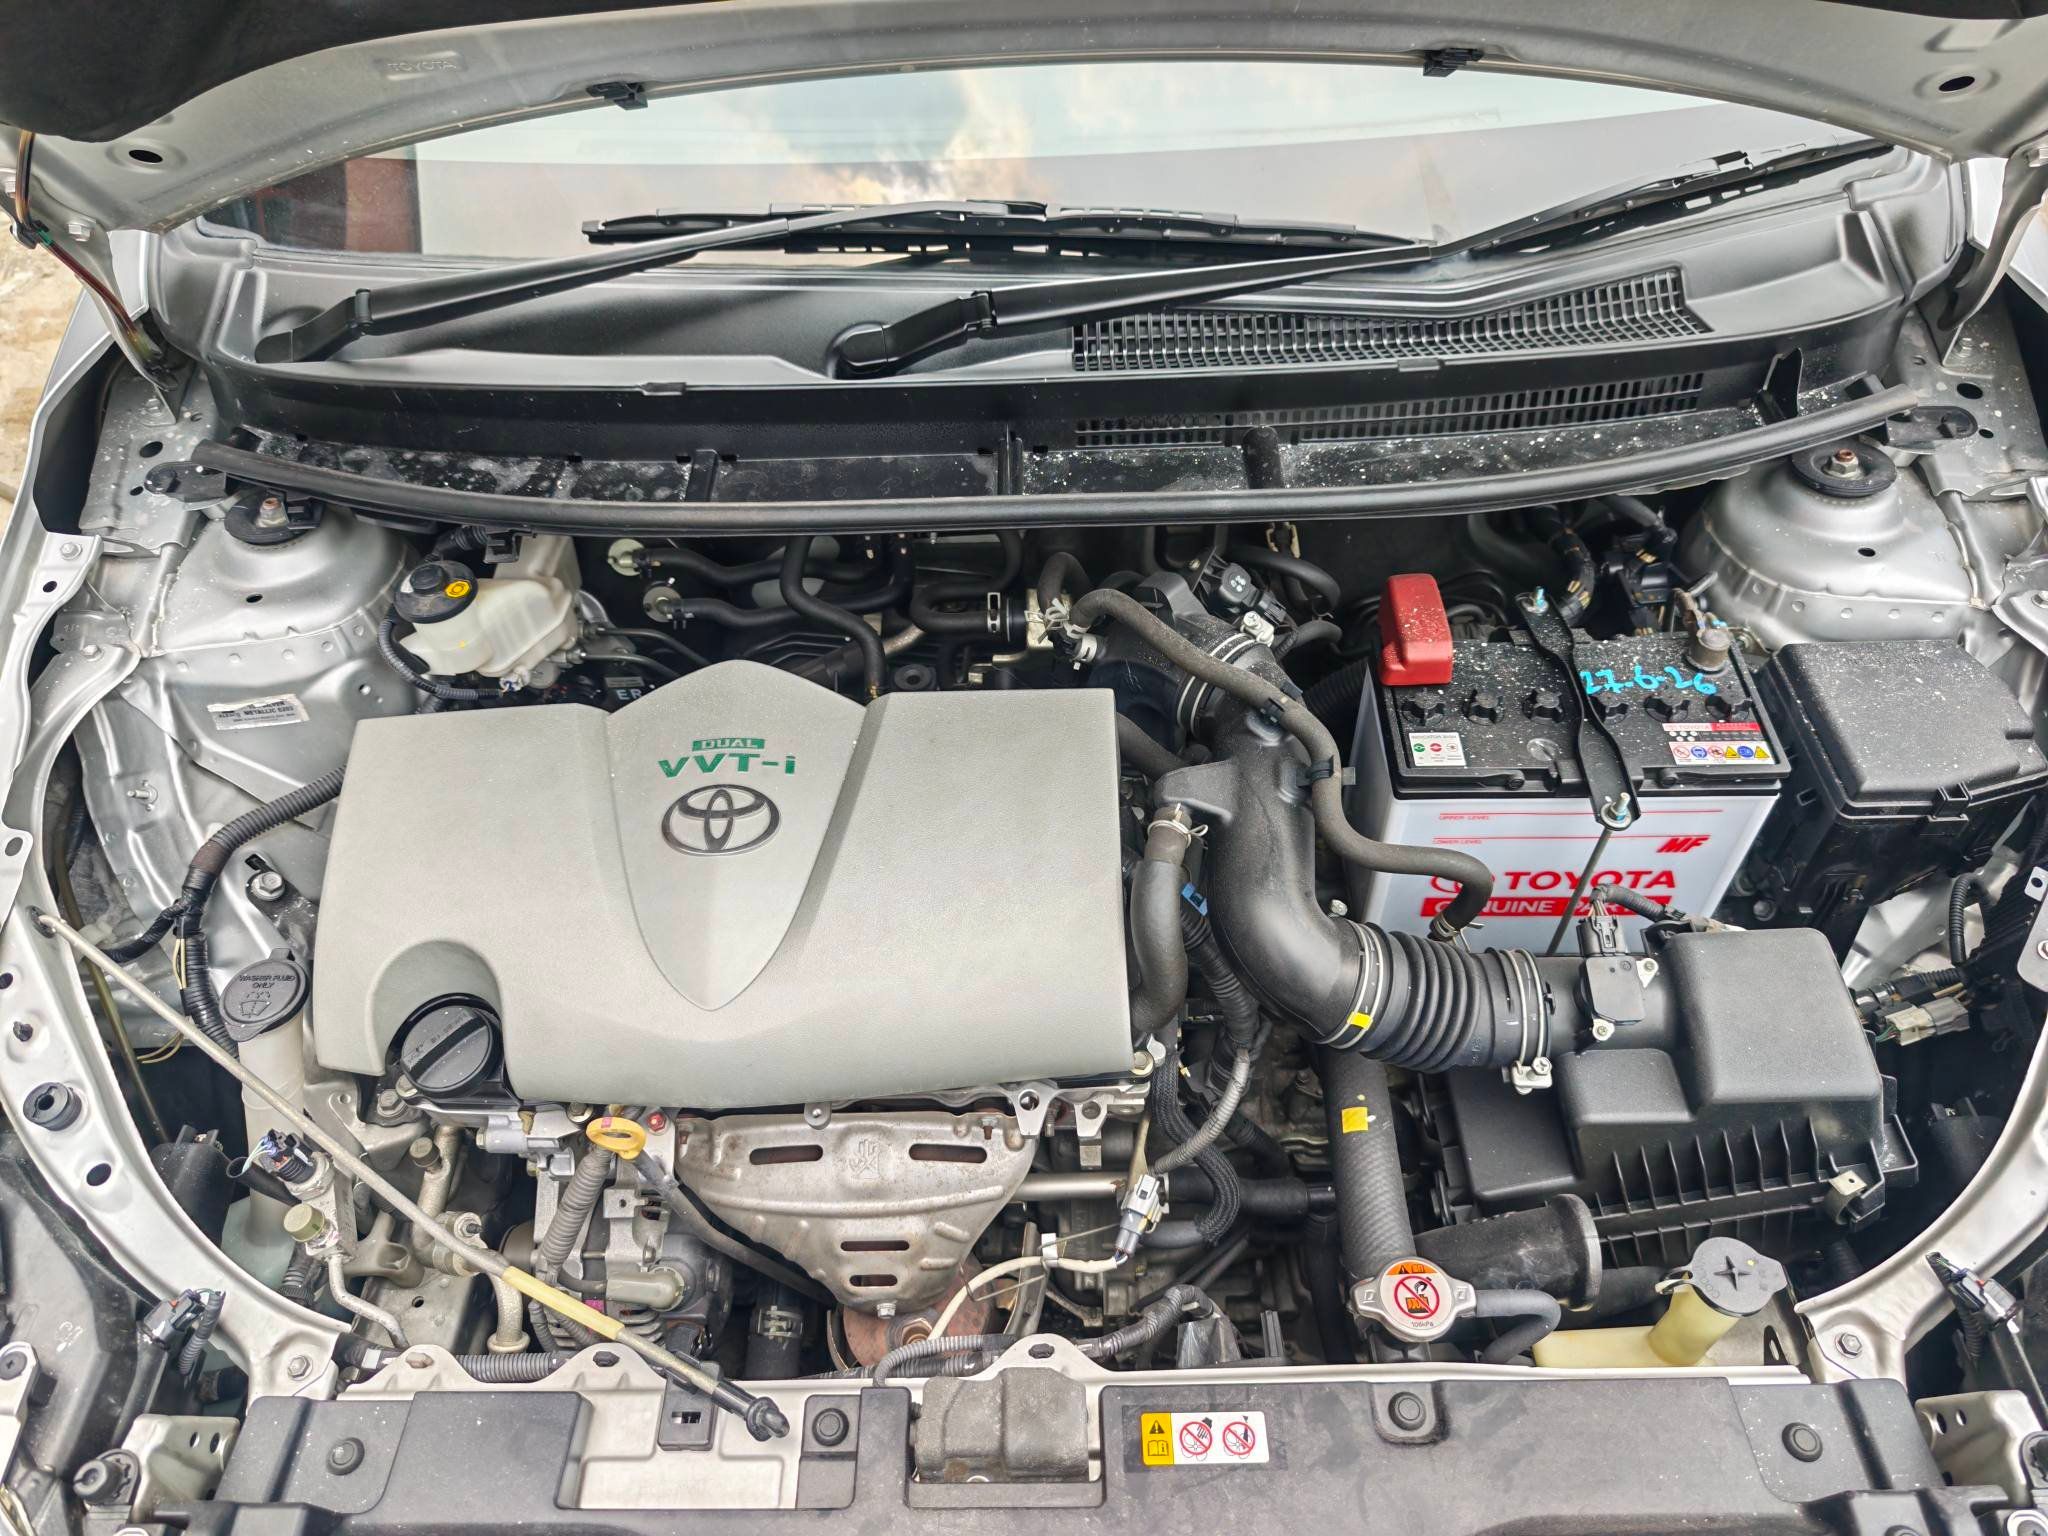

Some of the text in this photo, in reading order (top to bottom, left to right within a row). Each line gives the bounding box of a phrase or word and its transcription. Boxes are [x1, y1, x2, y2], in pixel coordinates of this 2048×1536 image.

[701, 738, 758, 749] DUAL
[658, 753, 796, 778] VVT-i
[1656, 836, 1710, 853] MF
[1504, 869, 1676, 891] TOYOTA
